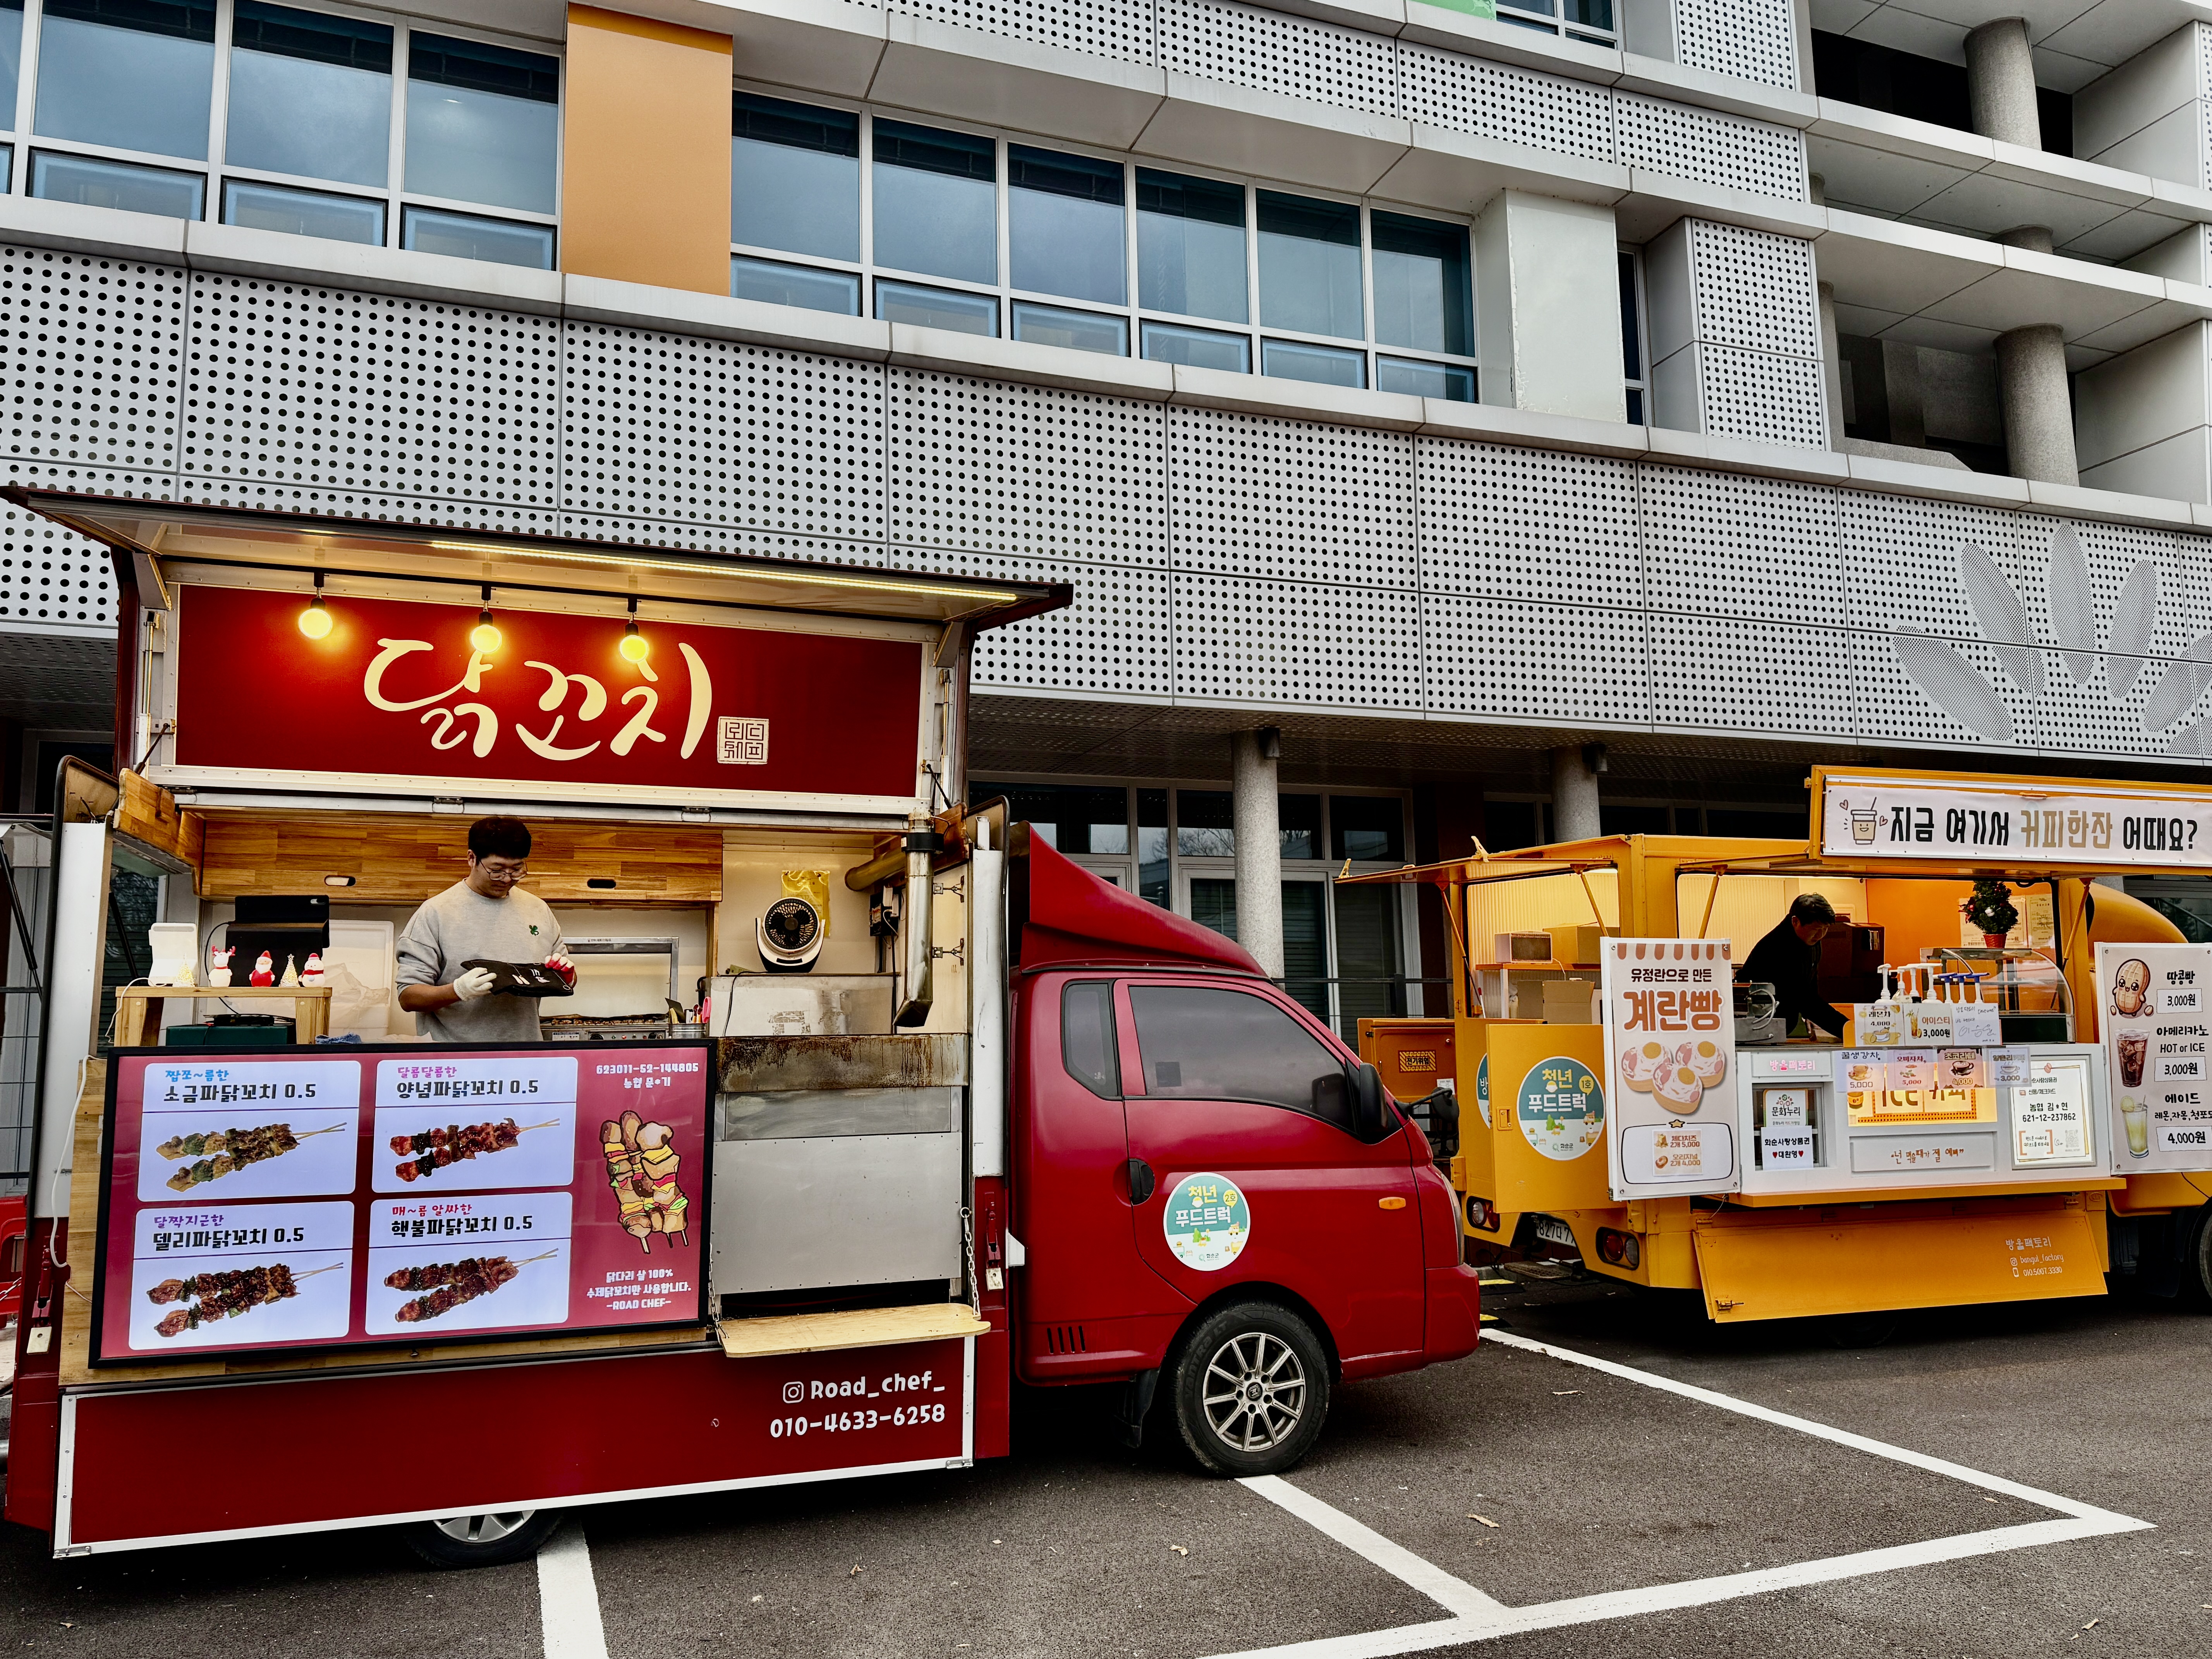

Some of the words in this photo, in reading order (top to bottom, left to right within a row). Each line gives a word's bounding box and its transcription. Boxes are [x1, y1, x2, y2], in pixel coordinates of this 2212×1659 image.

[364, 638, 712, 760] 닭꼬치
[1890, 807, 1934, 843] 지금
[1946, 809, 2009, 847] 여기서
[2021, 810, 2113, 850] 커피한잔
[2123, 816, 2198, 851] 어때요?
[1631, 969, 1688, 982] 유정란으로
[1693, 969, 1712, 982] 만든
[2167, 970, 2195, 984] 땅콩빵
[2167, 994, 2196, 1007] 3,000원
[1623, 989, 1722, 1031] 계란빵
[1922, 1017, 1950, 1025] 아이스티
[1923, 1029, 1950, 1038] 3,000원
[2156, 1025, 2209, 1037] 아메리카노
[2160, 1044, 2177, 1053] HOT
[2190, 1043, 2205, 1052] ICE
[1944, 1052, 1976, 1060] 초코라떼
[397, 1066, 457, 1079] 달콤달콤한
[596, 1063, 699, 1074] 623011-52-144805
[2164, 1063, 2198, 1075] 3,000원
[165, 1070, 229, 1082] 짭쪼~름한
[1542, 1069, 1572, 1092] 청년
[397, 1080, 503, 1099] 양념파닭꼬치
[510, 1080, 538, 1094] 0.5
[623, 1077, 642, 1089] 농협
[1581, 1080, 1591, 1089] 1호
[164, 1084, 276, 1103] 소금파닭꼬치
[284, 1084, 316, 1098] 0.5
[2164, 1093, 2201, 1104] 에이드
[1528, 1093, 1586, 1113] 푸드트럭
[2030, 1103, 2043, 1111] 농협
[1772, 1106, 1800, 1116] 문화누리
[2023, 1113, 2076, 1122] 621-12-237862
[1765, 1137, 1810, 1146] 화순사랑상품권
[2167, 1132, 2206, 1145] 4,000원
[1932, 1148, 1941, 1163] 젤
[1188, 1184, 1218, 1208] 청년
[1224, 1194, 1236, 1202] 2호
[392, 1205, 427, 1217] 매~콤
[432, 1204, 472, 1216] 알싸한
[1176, 1206, 1231, 1227] 푸드트럭
[154, 1214, 224, 1228] 달짝지근한
[391, 1216, 497, 1237] 핵불파닭꼬치
[504, 1216, 532, 1230] 0.5
[153, 1228, 267, 1251] 델리파닭꼬치
[274, 1228, 304, 1243] 0.5
[2020, 1253, 2064, 1265] bangul_factory
[606, 1271, 634, 1283] 닭다리
[636, 1269, 646, 1281] 살
[648, 1269, 673, 1279] 100%
[587, 1285, 641, 1298] 수제닭꼬치만
[643, 1281, 691, 1294] 사용합니다.
[811, 1371, 945, 1399] Road_chef_
[770, 1403, 945, 1438] 010-4633-6258
